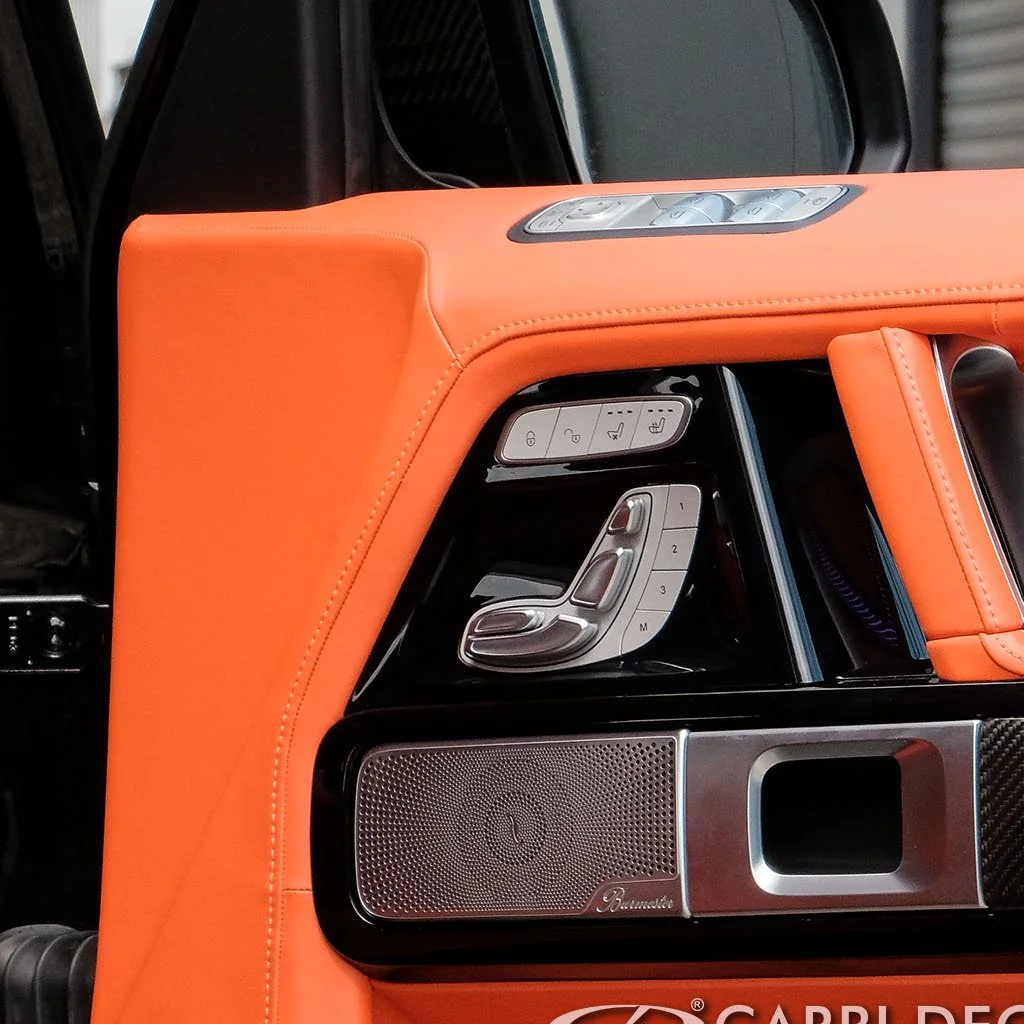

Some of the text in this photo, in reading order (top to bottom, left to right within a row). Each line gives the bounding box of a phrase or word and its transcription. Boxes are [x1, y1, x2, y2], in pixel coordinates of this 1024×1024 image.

[671, 544, 678, 554] 2
[660, 585, 667, 595] 3
[639, 623, 648, 632] M
[596, 886, 674, 913] Burmester
